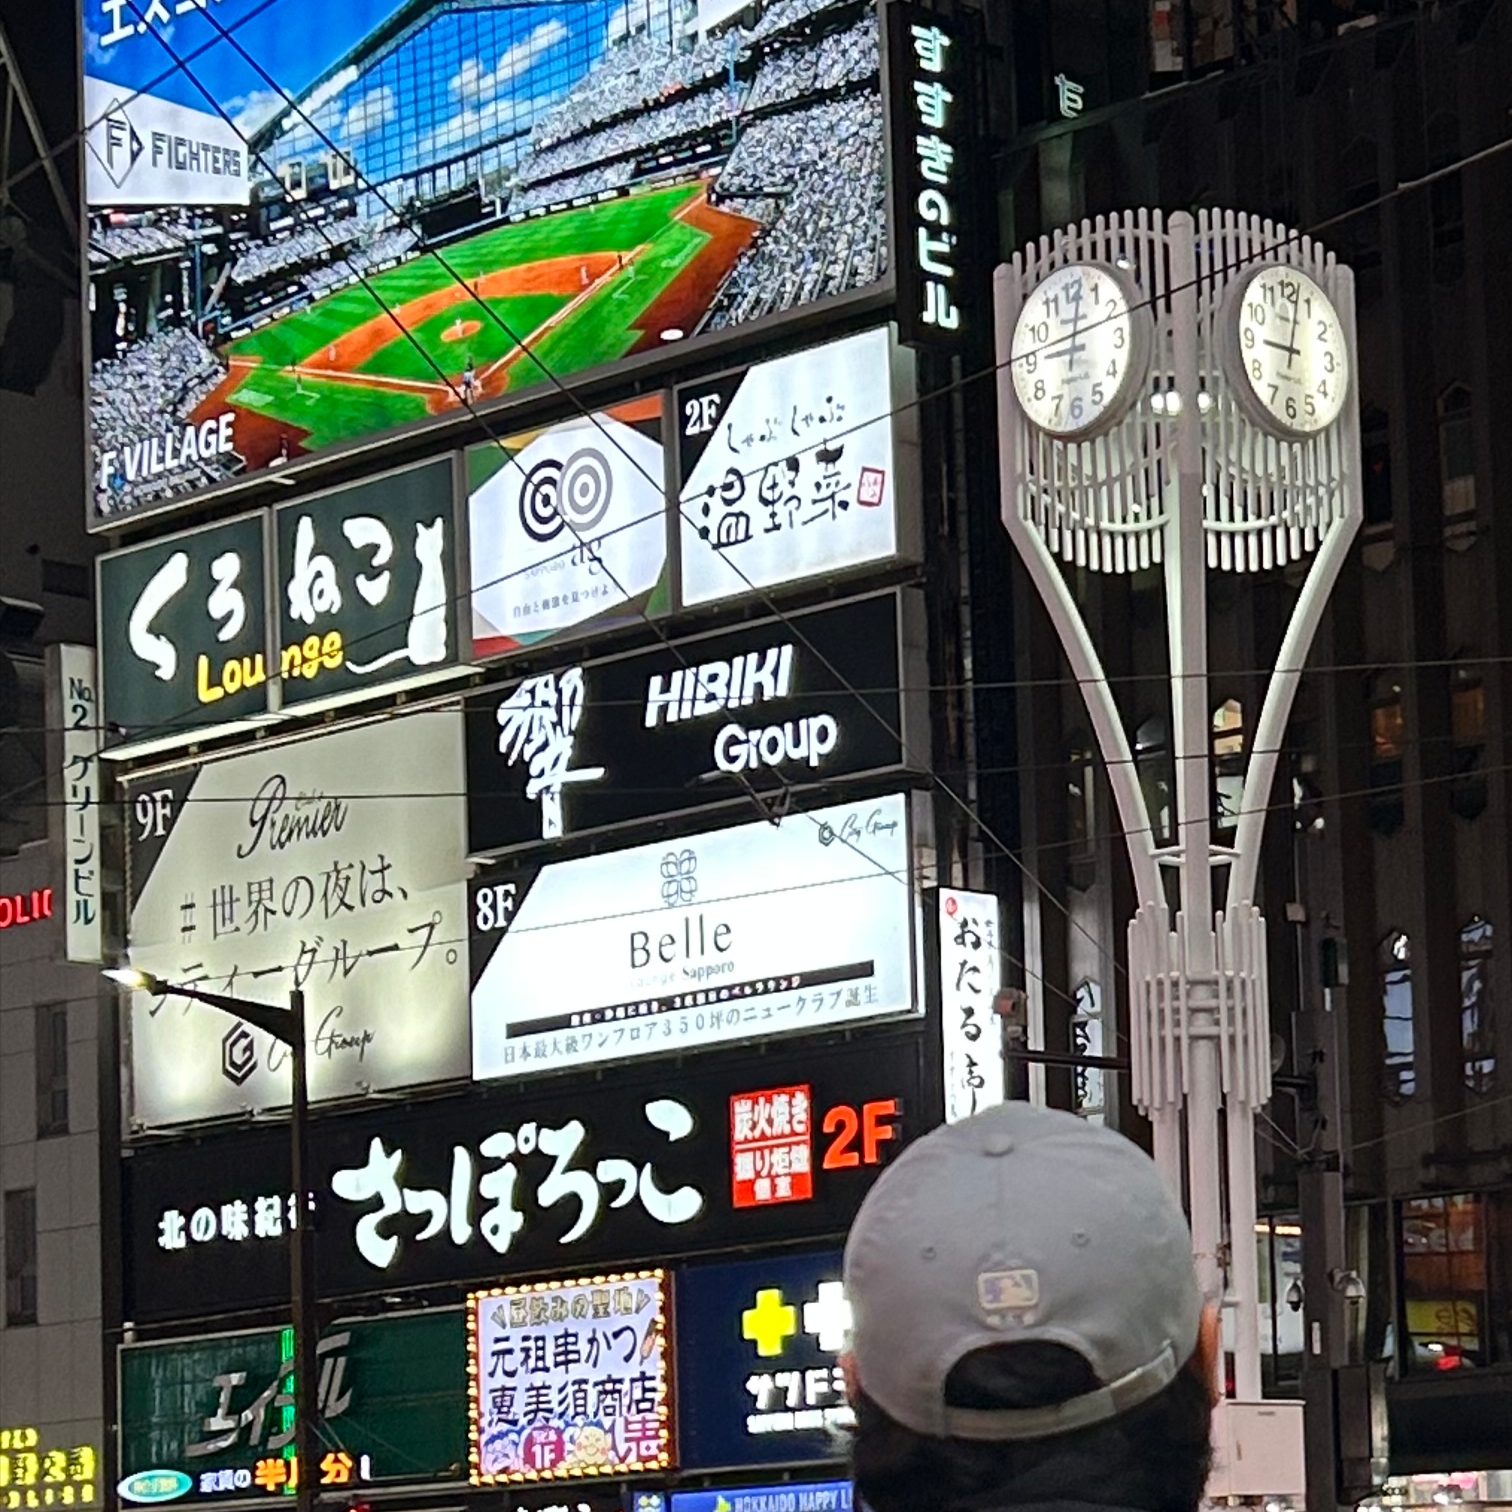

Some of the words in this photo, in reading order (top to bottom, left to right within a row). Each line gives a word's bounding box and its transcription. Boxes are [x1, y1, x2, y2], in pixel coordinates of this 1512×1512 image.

[151, 130, 241, 178] FIGHTERS
[911, 24, 959, 329] すすきのビル
[1062, 278, 1083, 303] 12
[1090, 282, 1100, 305] 1
[1260, 282, 1275, 308] 11
[1278, 279, 1298, 303] 12
[1042, 293, 1059, 318] 11
[1105, 299, 1118, 320] 2
[1247, 302, 1266, 326] 10
[1304, 297, 1312, 319] 1
[1028, 321, 1049, 344] 10
[1113, 327, 1125, 349] 3
[1244, 327, 1255, 349] 9
[1317, 320, 1328, 343] 2
[1025, 350, 1037, 374] 9
[1106, 358, 1118, 380] 4
[1252, 358, 1263, 380] 8
[1323, 351, 1335, 373] 3
[1033, 379, 1046, 401] 8
[1091, 382, 1103, 406] 5
[1267, 383, 1279, 405] 7
[1317, 379, 1328, 399] 4
[684, 393, 721, 436] 2F
[1051, 394, 1063, 417] 7
[1070, 396, 1083, 419] 6
[1285, 397, 1297, 419] 6
[1304, 394, 1316, 416] 5
[100, 450, 118, 489] F
[123, 412, 237, 481] VILLAGE
[699, 438, 852, 550] 温野菜
[128, 514, 394, 681] くろねこ
[196, 630, 344, 703] Lounge
[644, 644, 794, 728] HIBIKI
[714, 714, 839, 774] Group
[135, 788, 173, 841] 9F
[237, 774, 349, 859] Premier
[476, 883, 517, 932] 8F
[629, 912, 733, 970] Belle
[682, 960, 736, 984] Sapporo
[822, 1099, 896, 1170] 2F
[331, 1098, 704, 1269] さっぽろっこ
[488, 1324, 638, 1379] 元祖串かつ
[487, 1370, 659, 1429] 恵美須商店
[799, 1489, 837, 1512] HAPPY
